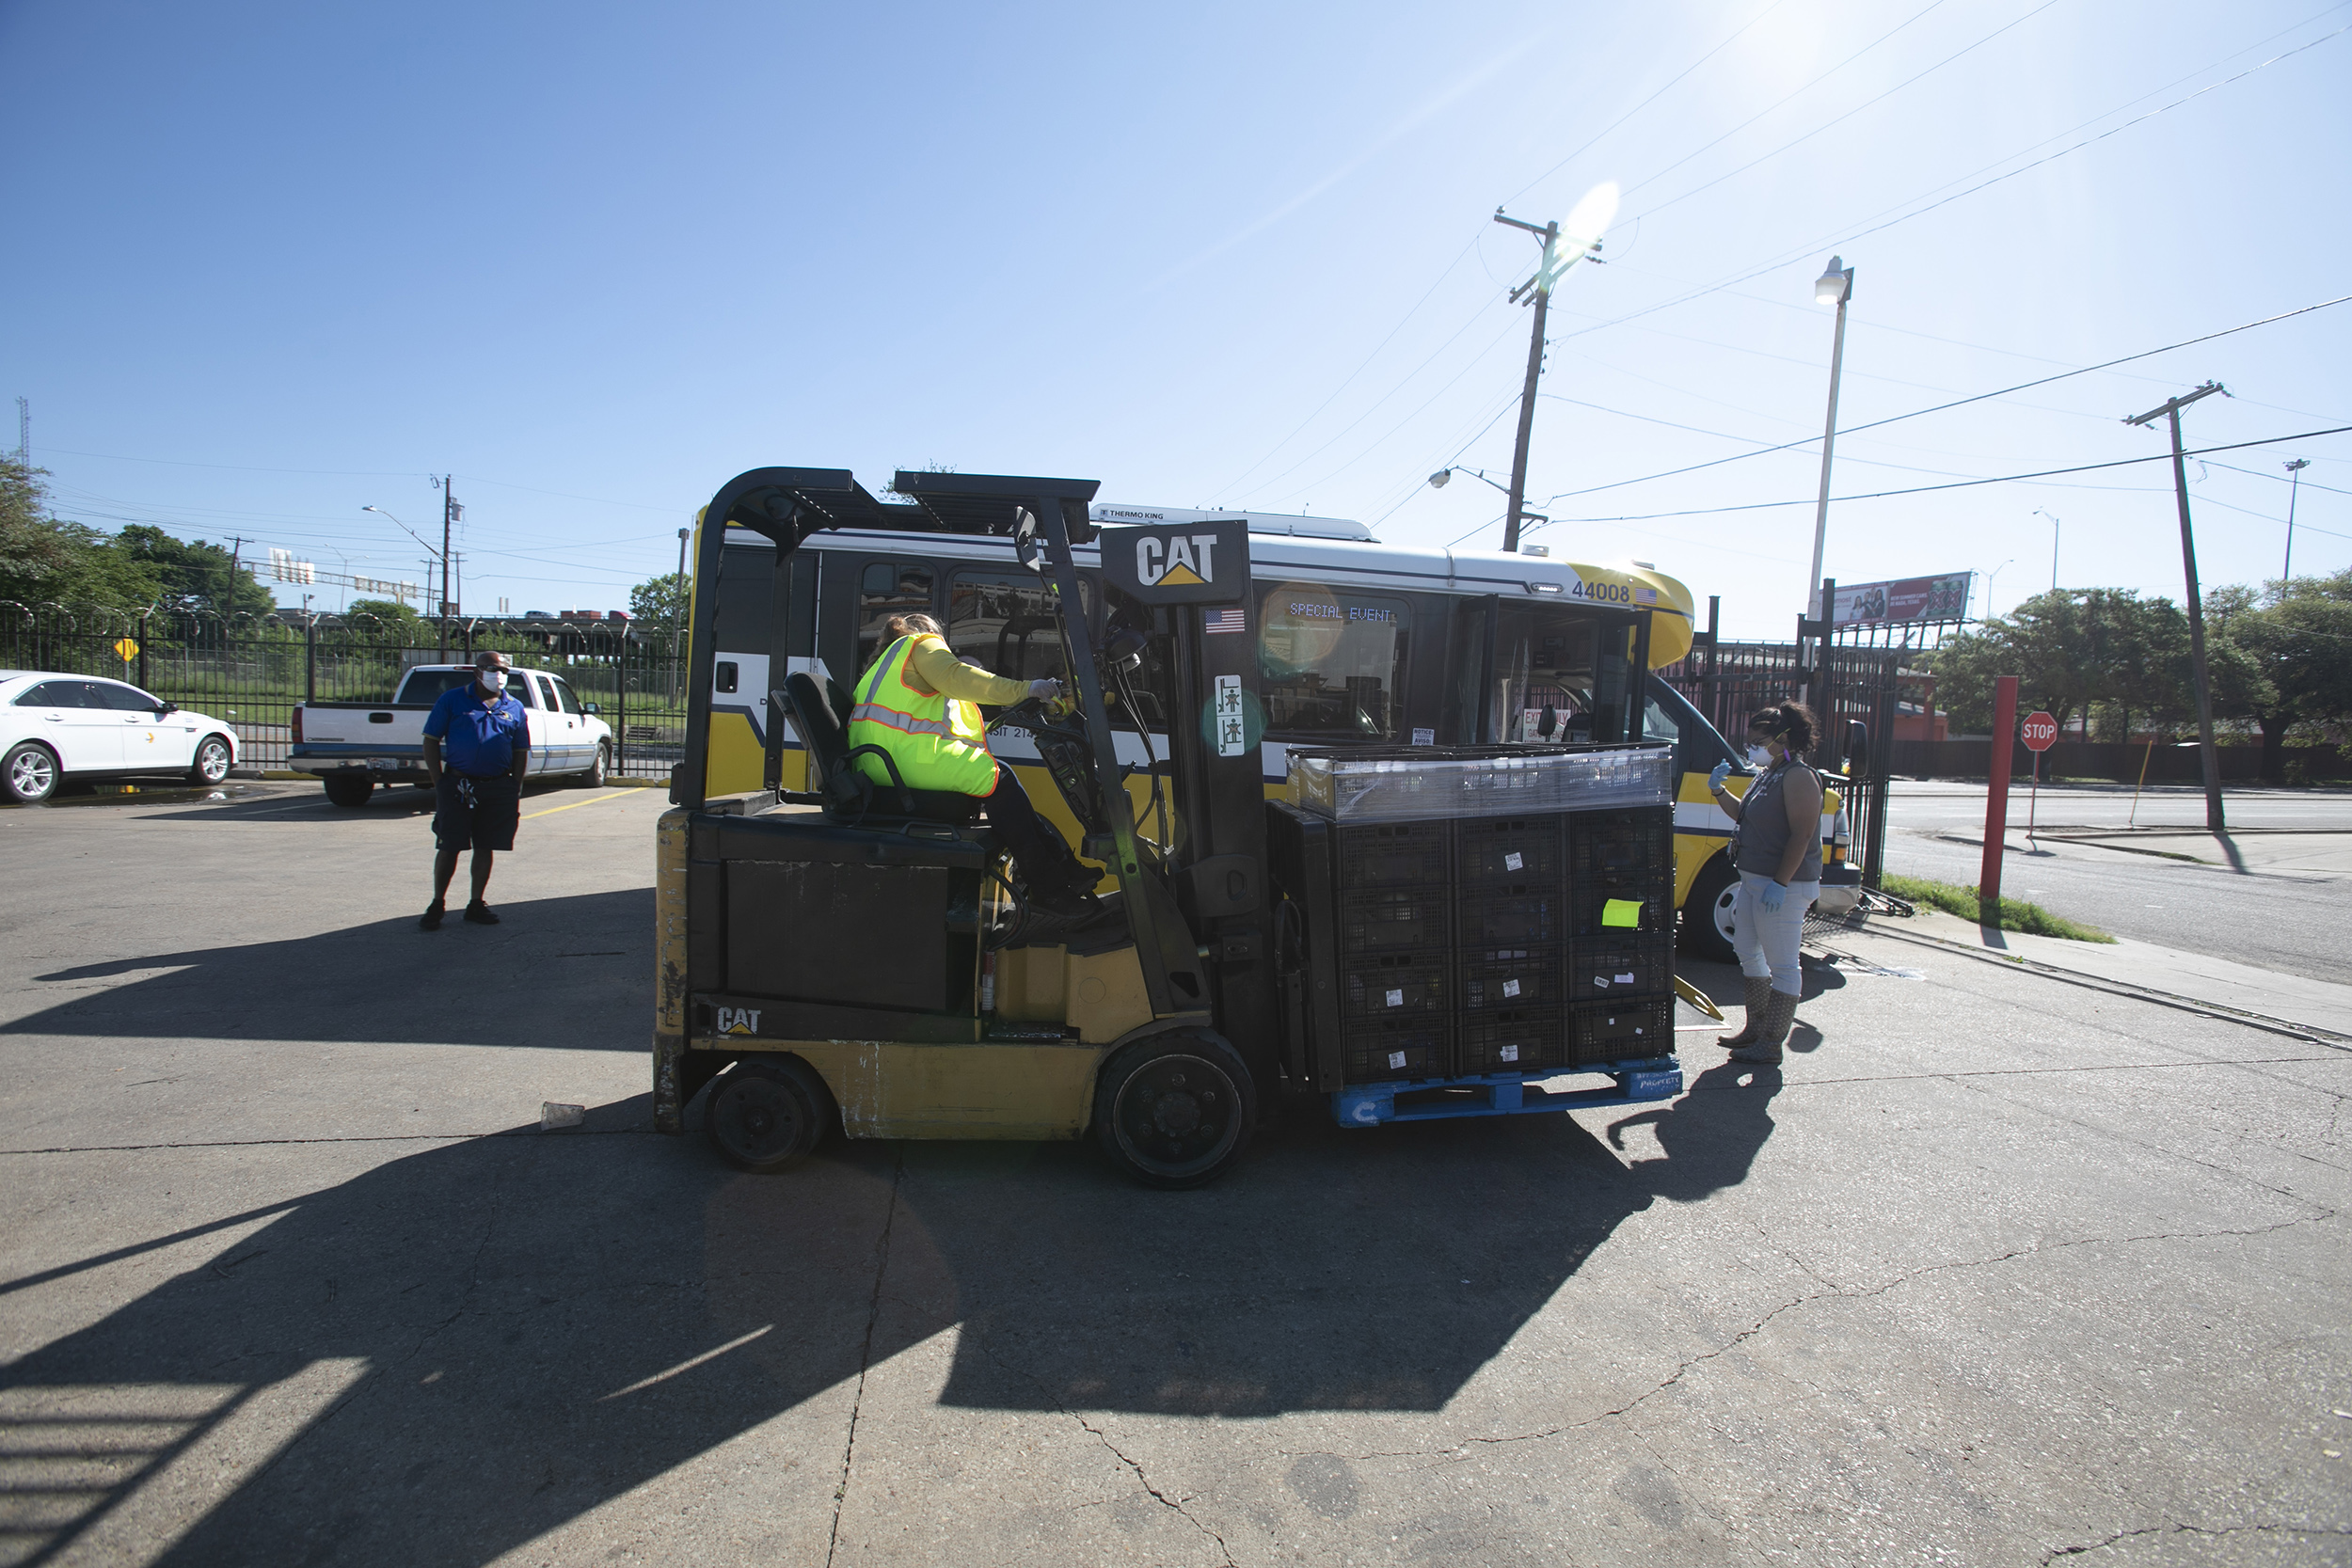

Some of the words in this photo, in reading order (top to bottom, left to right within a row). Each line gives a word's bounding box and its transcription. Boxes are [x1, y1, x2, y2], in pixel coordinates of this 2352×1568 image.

[1110, 510, 1143, 518] THERMO
[1136, 534, 1217, 586] CAT
[1572, 580, 1629, 603] 44008
[1290, 603, 1343, 619] SPECIAL
[1349, 608, 1391, 622] EVENT
[2024, 723, 2055, 739] STOP
[718, 1006, 761, 1034] CAT
